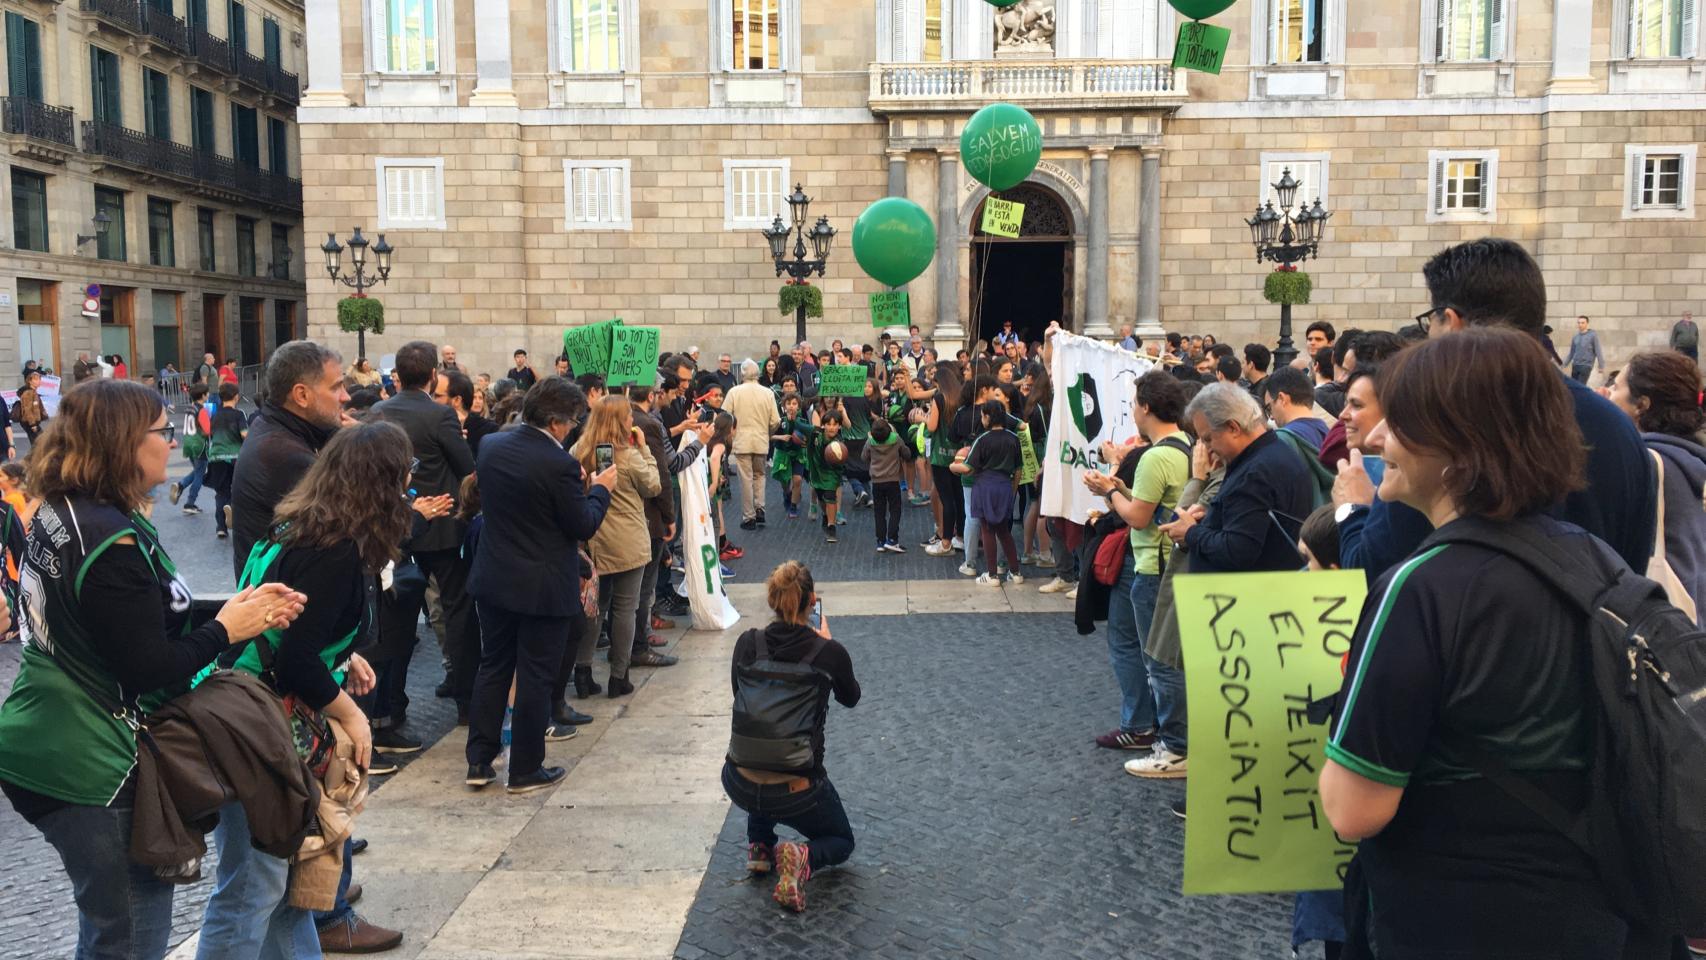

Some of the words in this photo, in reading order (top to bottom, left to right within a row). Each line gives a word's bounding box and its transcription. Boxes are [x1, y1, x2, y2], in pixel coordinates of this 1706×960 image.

[969, 123, 1029, 155] SALVEM
[617, 330, 627, 342] NO
[630, 330, 644, 344] TOT
[1269, 611, 1304, 669] EL
